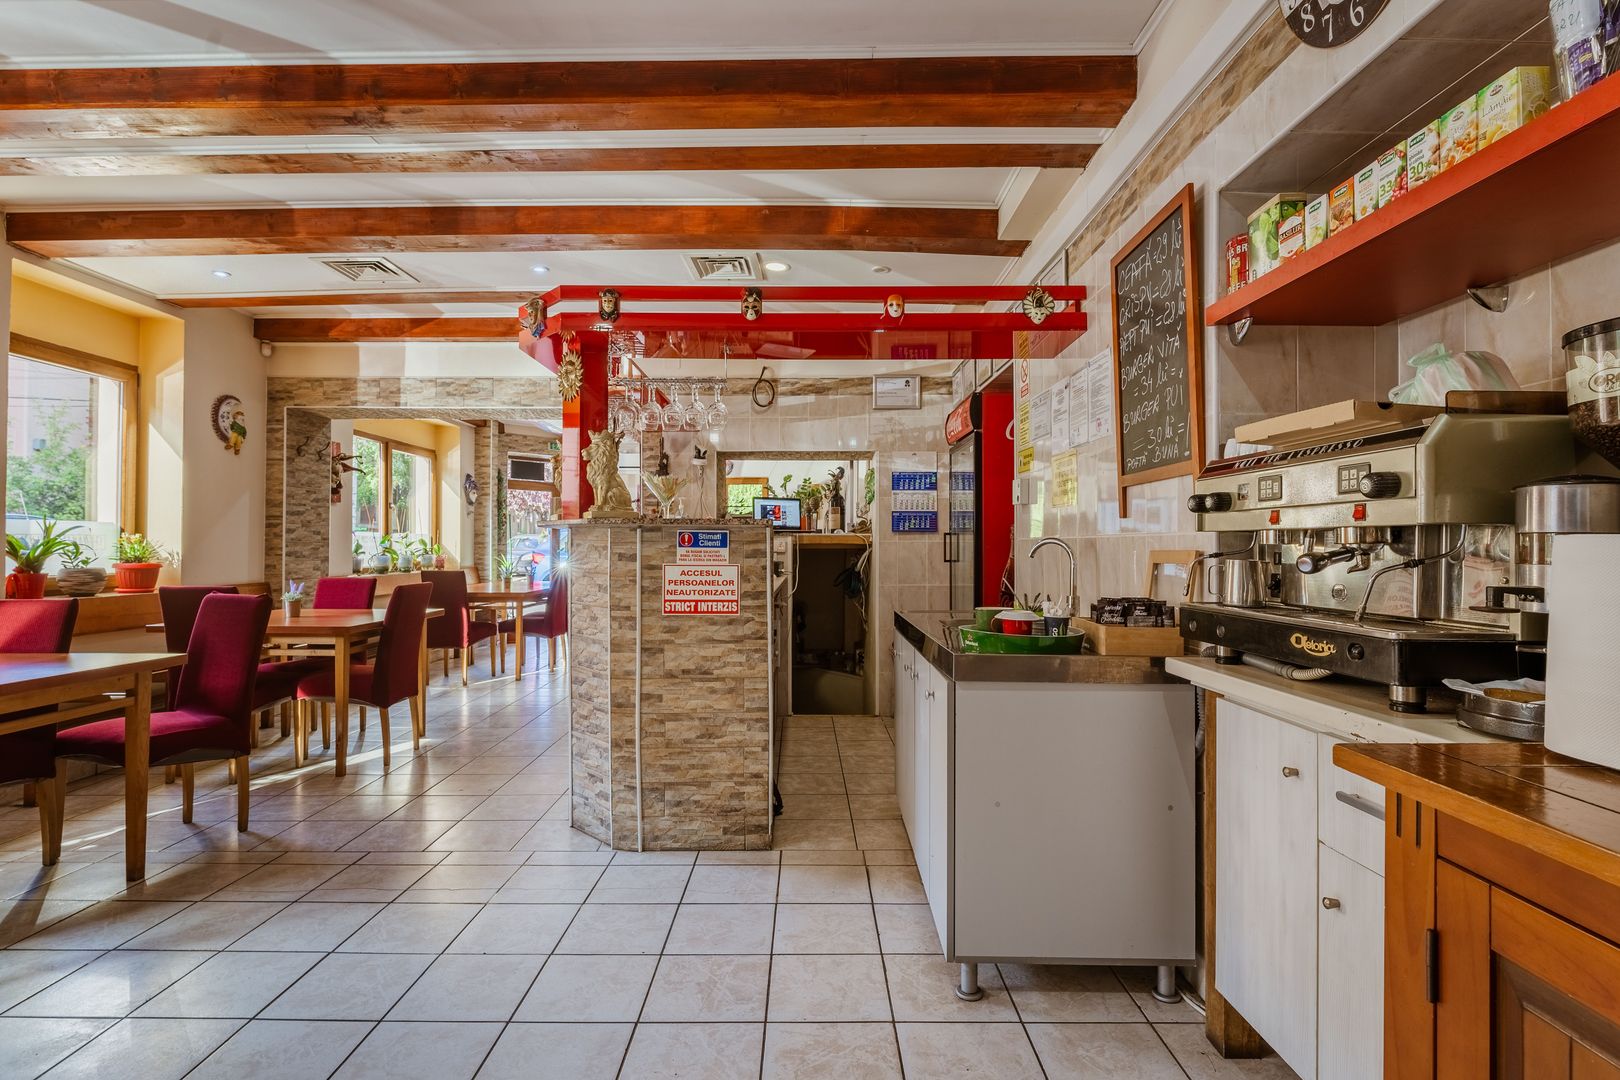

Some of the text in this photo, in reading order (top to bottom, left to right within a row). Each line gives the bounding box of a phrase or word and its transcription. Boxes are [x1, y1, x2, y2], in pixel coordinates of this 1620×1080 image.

[698, 539, 721, 547] Clienti
[679, 569, 722, 577] ACCESUL
[668, 579, 735, 587] PERSOANELOR
[664, 601, 738, 612] STRICT INTERZIS
